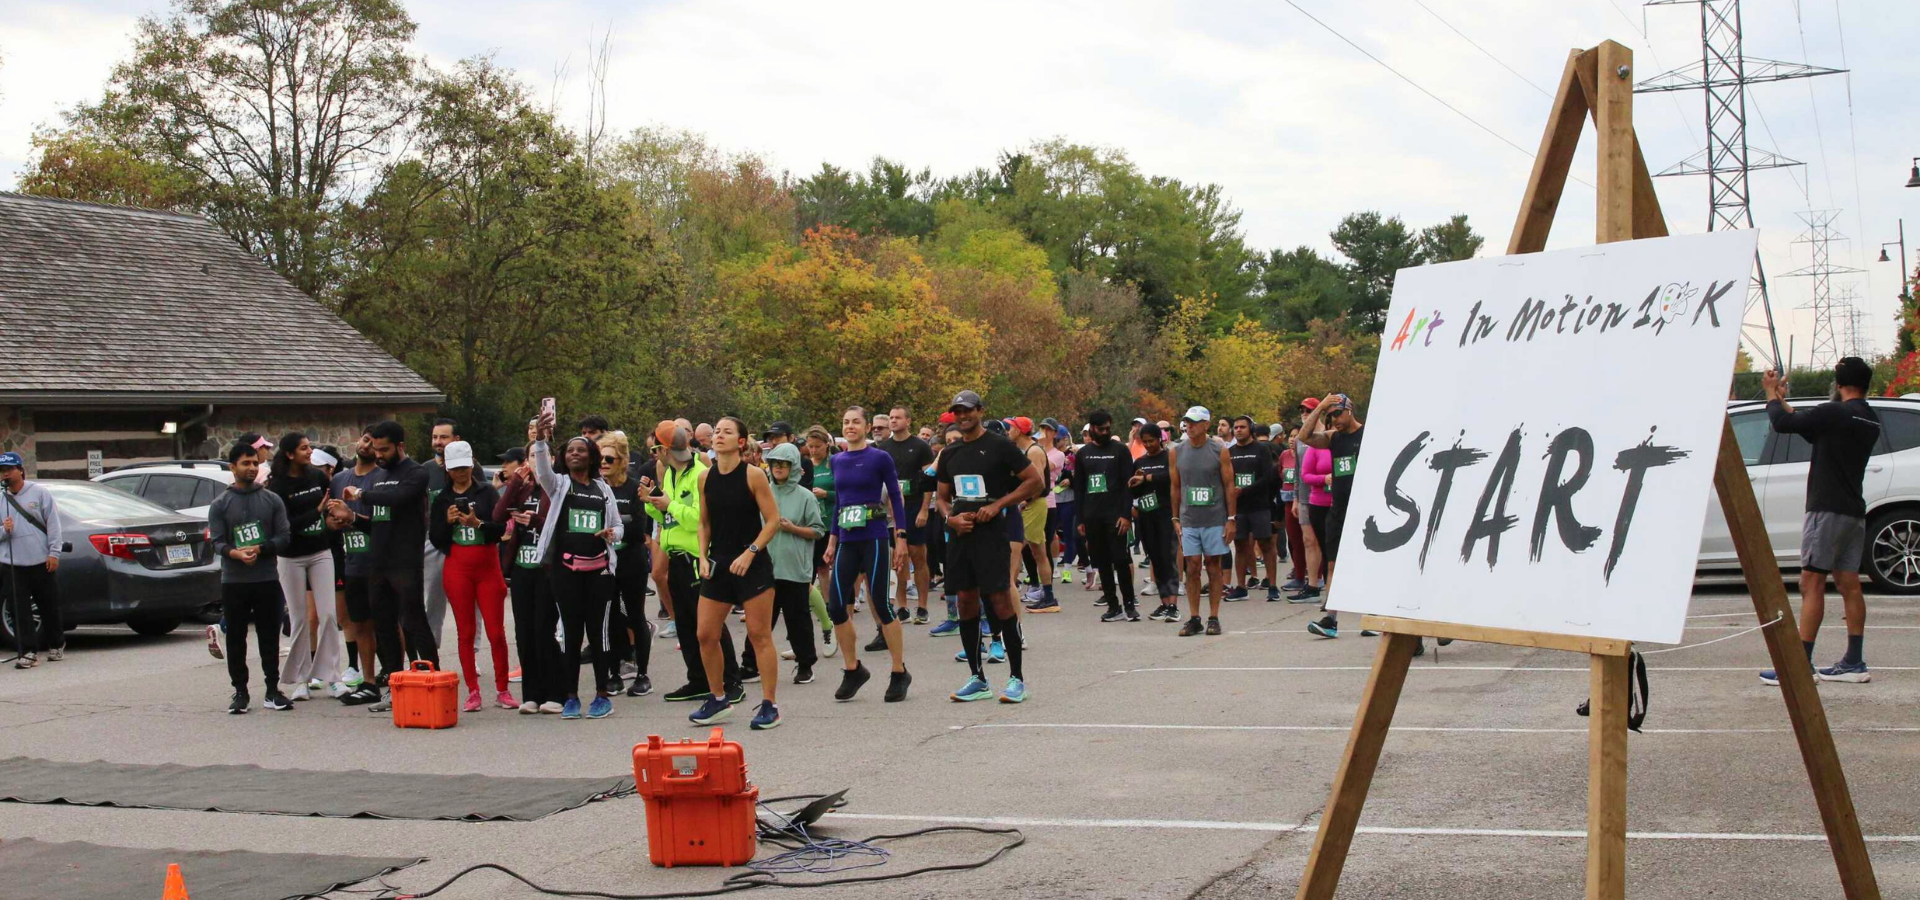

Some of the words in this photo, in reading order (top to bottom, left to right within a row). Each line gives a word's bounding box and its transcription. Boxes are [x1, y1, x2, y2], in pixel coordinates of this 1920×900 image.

[1390, 307, 1445, 351] Art
[1459, 300, 1500, 348] In
[1506, 294, 1631, 342] Motion
[1339, 460, 1351, 472] 38
[1090, 477, 1101, 488] 12
[1238, 476, 1252, 486] 165
[1140, 496, 1155, 509] 115
[1191, 490, 1209, 502] 103
[1362, 422, 1693, 588] START
[574, 514, 597, 529] 118
[842, 509, 862, 524] 142
[237, 526, 260, 543] 138
[460, 527, 476, 541] 19
[347, 535, 366, 548] 133
[519, 550, 538, 564] 192
